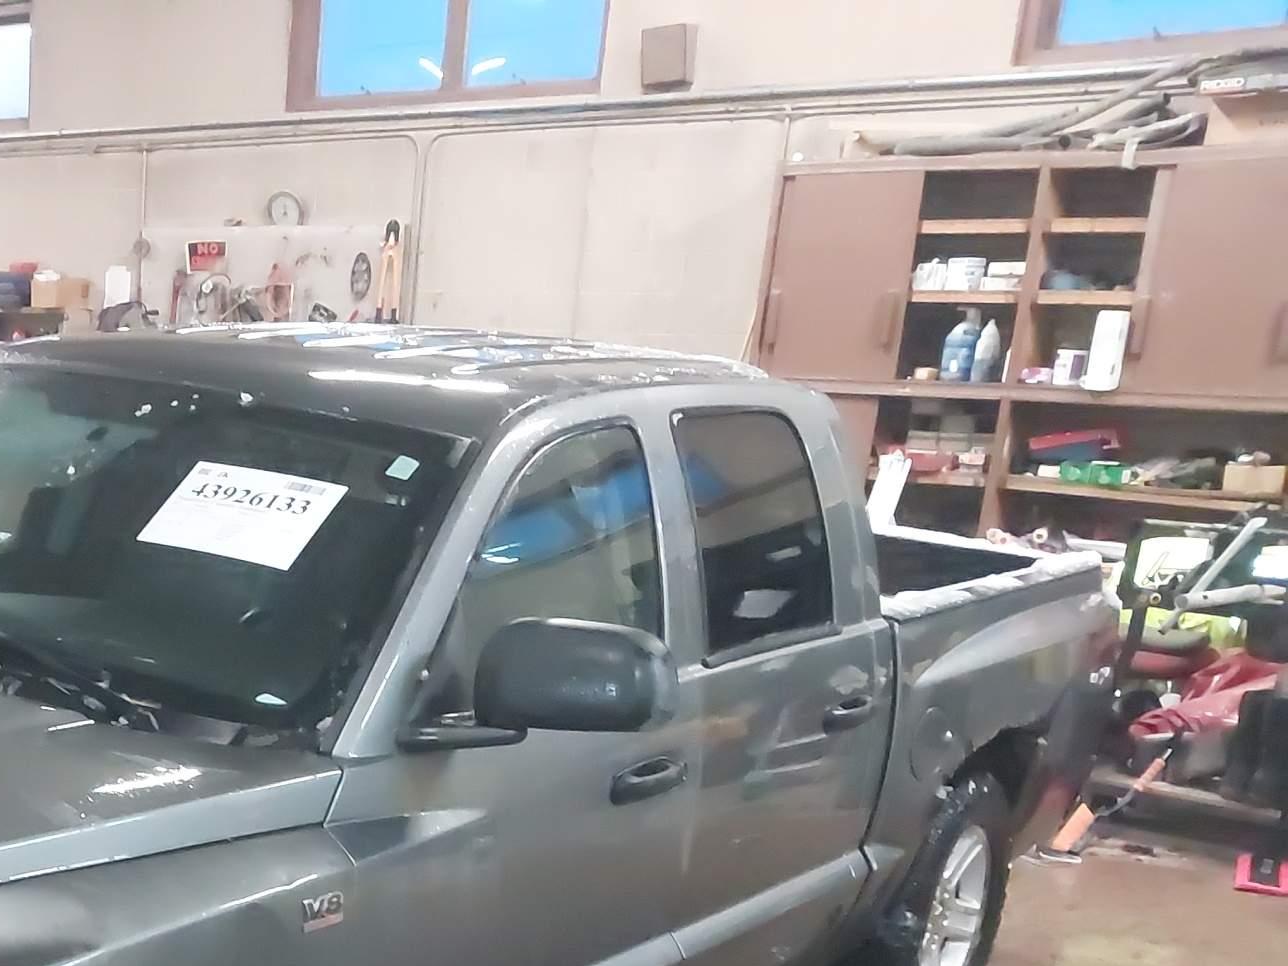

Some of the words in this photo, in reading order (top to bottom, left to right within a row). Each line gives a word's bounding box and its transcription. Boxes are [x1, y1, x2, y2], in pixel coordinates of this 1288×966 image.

[197, 243, 219, 255] NO
[191, 482, 312, 515] 43926133
[301, 890, 344, 920] V8
